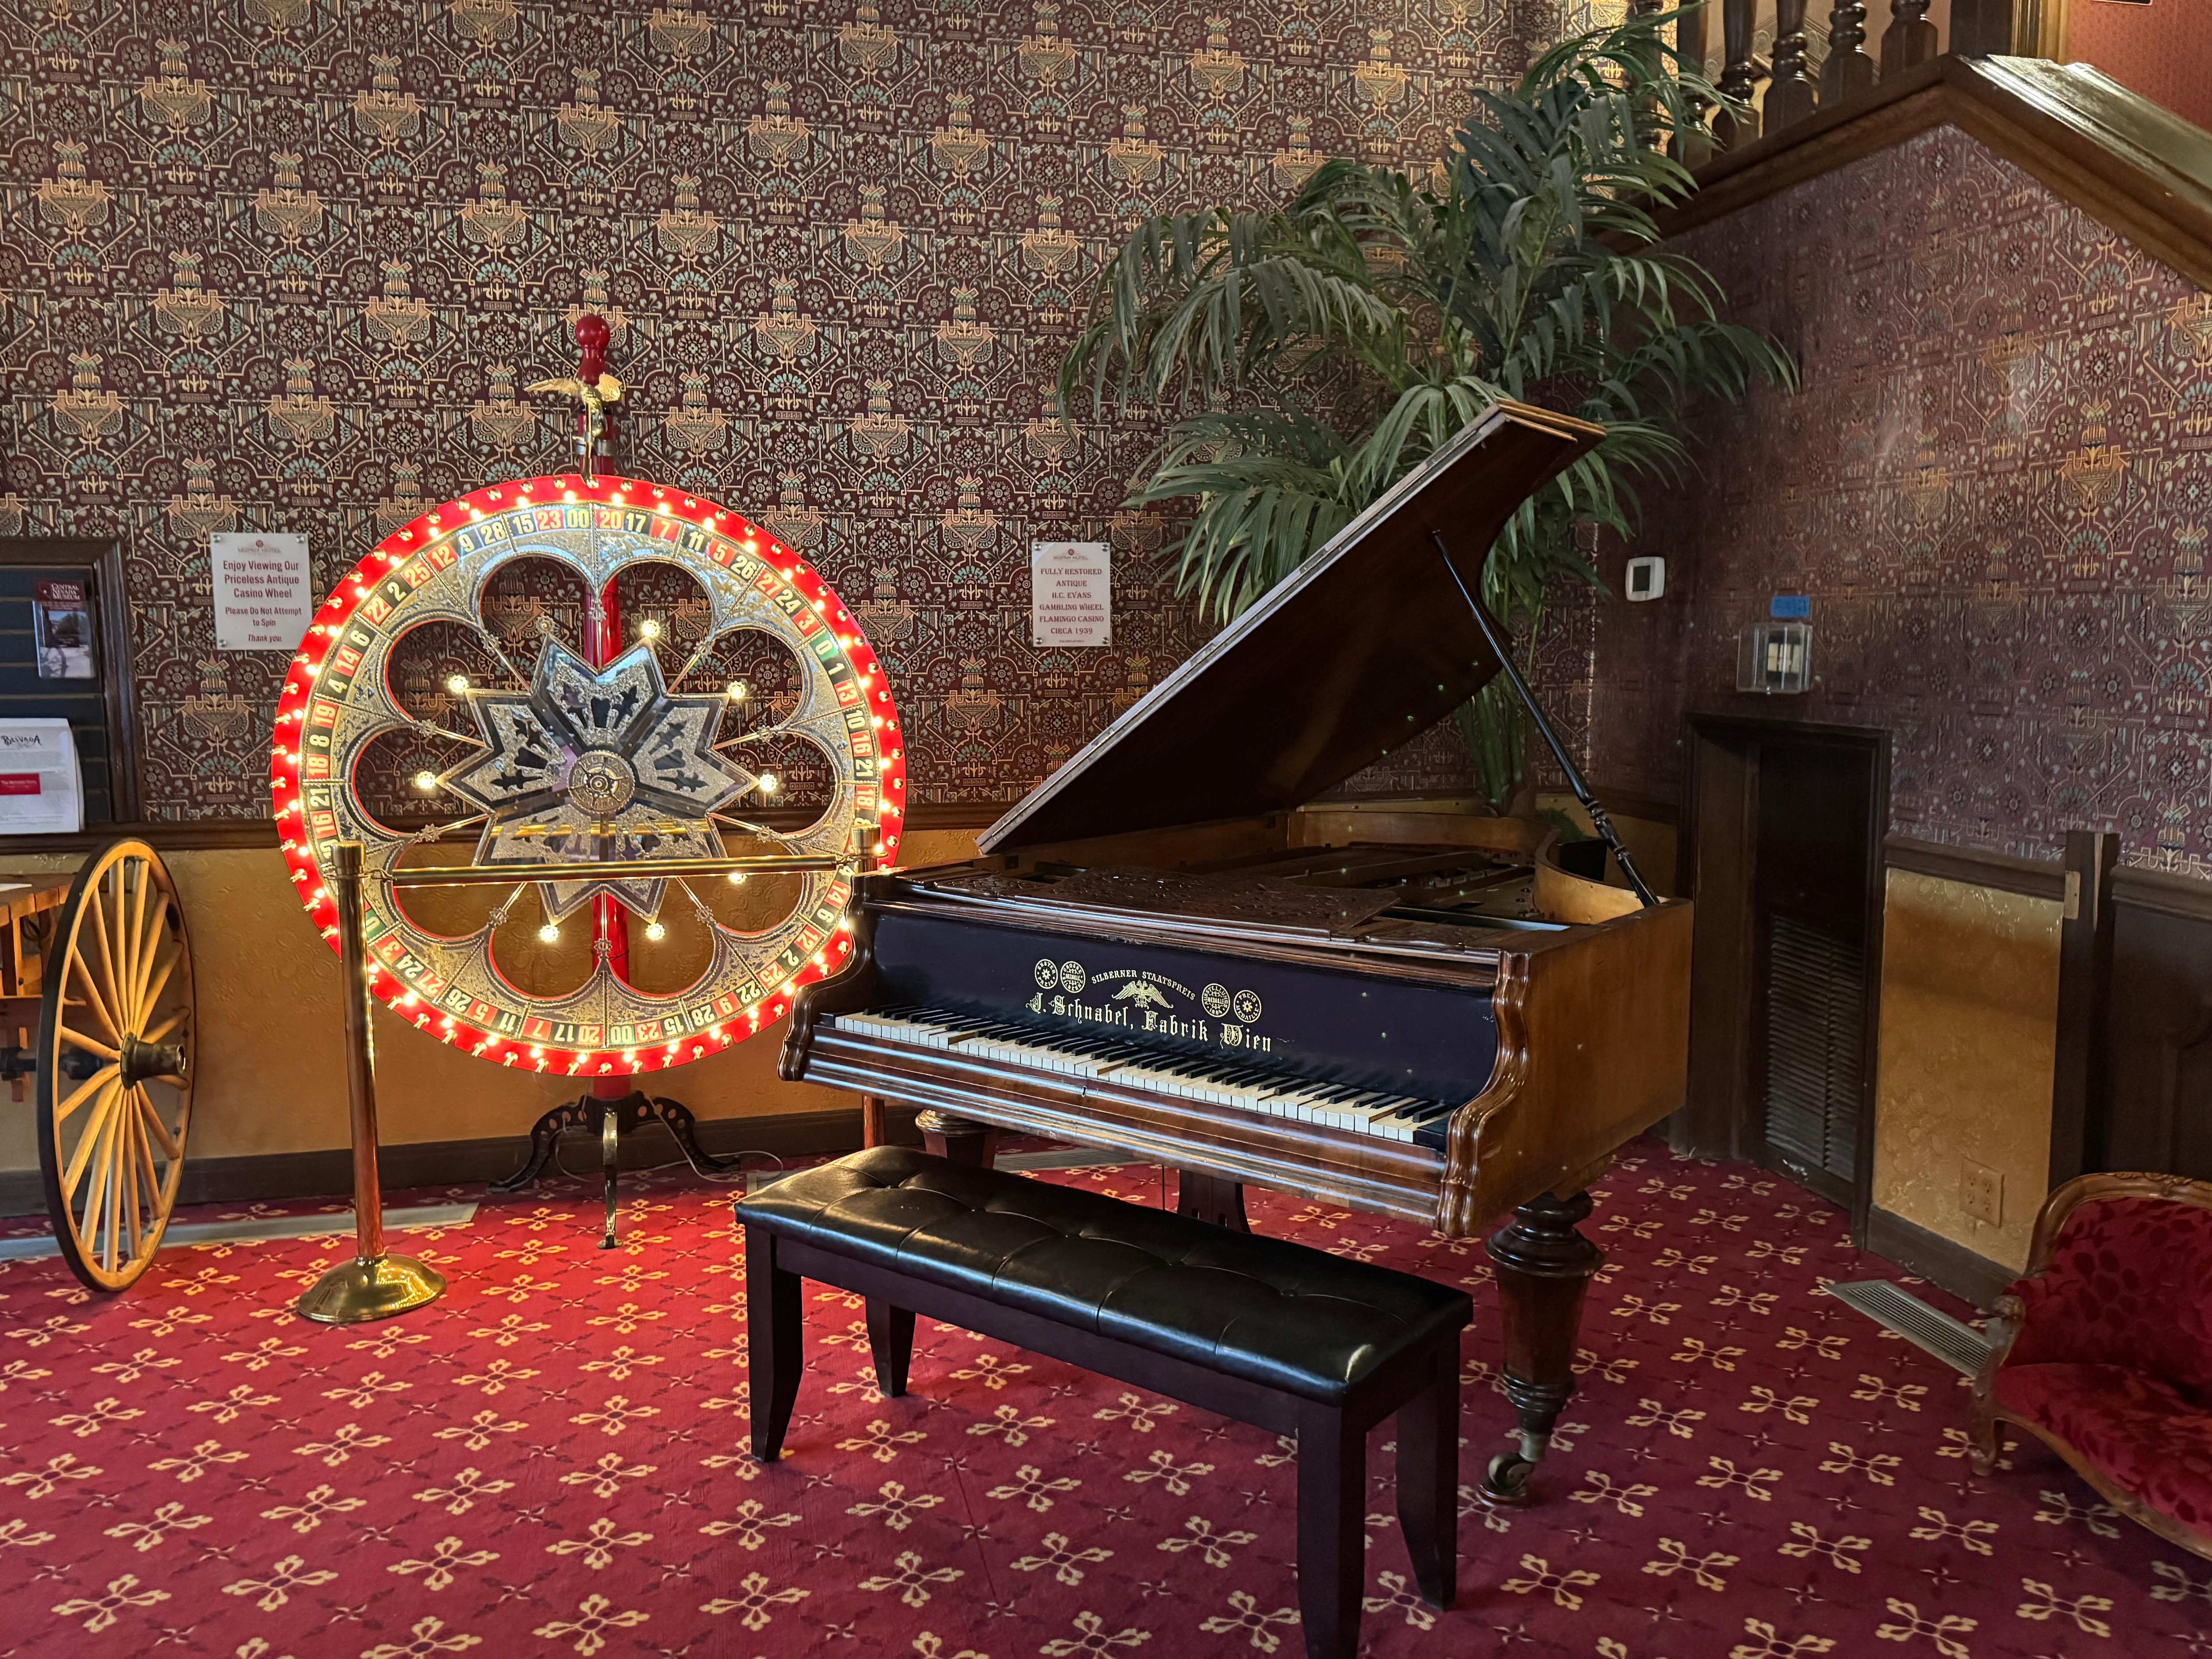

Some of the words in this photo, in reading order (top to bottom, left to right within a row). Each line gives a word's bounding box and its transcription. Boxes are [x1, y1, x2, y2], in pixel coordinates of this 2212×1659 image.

[514, 514, 534, 535] 15
[537, 511, 561, 530] 23
[567, 510, 589, 528] 00
[600, 511, 622, 530] 20
[626, 513, 646, 533] 17
[481, 523, 506, 545] 28
[658, 520, 669, 538] 7
[459, 534, 475, 553] 9
[689, 532, 705, 551] 11
[431, 545, 455, 568] 12
[714, 544, 728, 561] 5
[223, 560, 246, 571] Enjoy
[248, 561, 282, 572] Viewing
[284, 561, 299, 571] Our
[730, 555, 757, 579] 26
[224, 575, 264, 584] Priceless
[267, 575, 299, 586] Antique
[406, 566, 431, 587] 25
[757, 572, 781, 594] 27
[234, 588, 263, 598] Casino
[265, 588, 292, 598] Wheel
[389, 582, 407, 602] 2
[775, 589, 802, 614] 24
[274, 607, 301, 616] Attempt
[365, 599, 387, 624] 22
[261, 619, 276, 627] Spin
[799, 614, 815, 630] 3
[350, 630, 370, 647] 6
[815, 640, 833, 656] 0
[336, 649, 360, 673] 14
[828, 663, 845, 674] 1
[328, 678, 347, 694] 4
[838, 681, 858, 703] 13
[315, 705, 336, 724] 19
[845, 710, 866, 730] 10
[310, 734, 330, 747] 8
[850, 734, 872, 755] 16
[309, 756, 328, 774] 18
[856, 759, 873, 777] 21
[310, 788, 330, 807] 21
[856, 789, 874, 808] 18
[312, 813, 335, 834] 16
[827, 885, 848, 905] 14
[817, 909, 834, 922] 6
[384, 941, 400, 957] 3
[797, 931, 820, 952] 12
[396, 954, 423, 978] 24
[782, 951, 799, 966] 2
[419, 974, 446, 994] 27
[760, 964, 784, 987] 25
[1091, 969, 1137, 984] SILBERNER
[1142, 971, 1196, 1001] STAATSPREIS
[446, 988, 472, 1011] 26
[736, 981, 760, 1002] 22
[473, 1003, 488, 1021] 5
[692, 1004, 715, 1024] 28
[719, 997, 733, 1014] 9
[1236, 1005, 1259, 1021] MEDAILLE
[499, 1012, 517, 1031] 11
[534, 1020, 543, 1037] 7
[664, 1017, 684, 1035] 15
[1141, 1010, 1208, 1042] Fabrik
[1220, 1022, 1271, 1052] Wien
[554, 1024, 574, 1042] 17
[581, 1026, 600, 1044] 20
[611, 1025, 632, 1043] 00
[638, 1023, 659, 1041] 23
